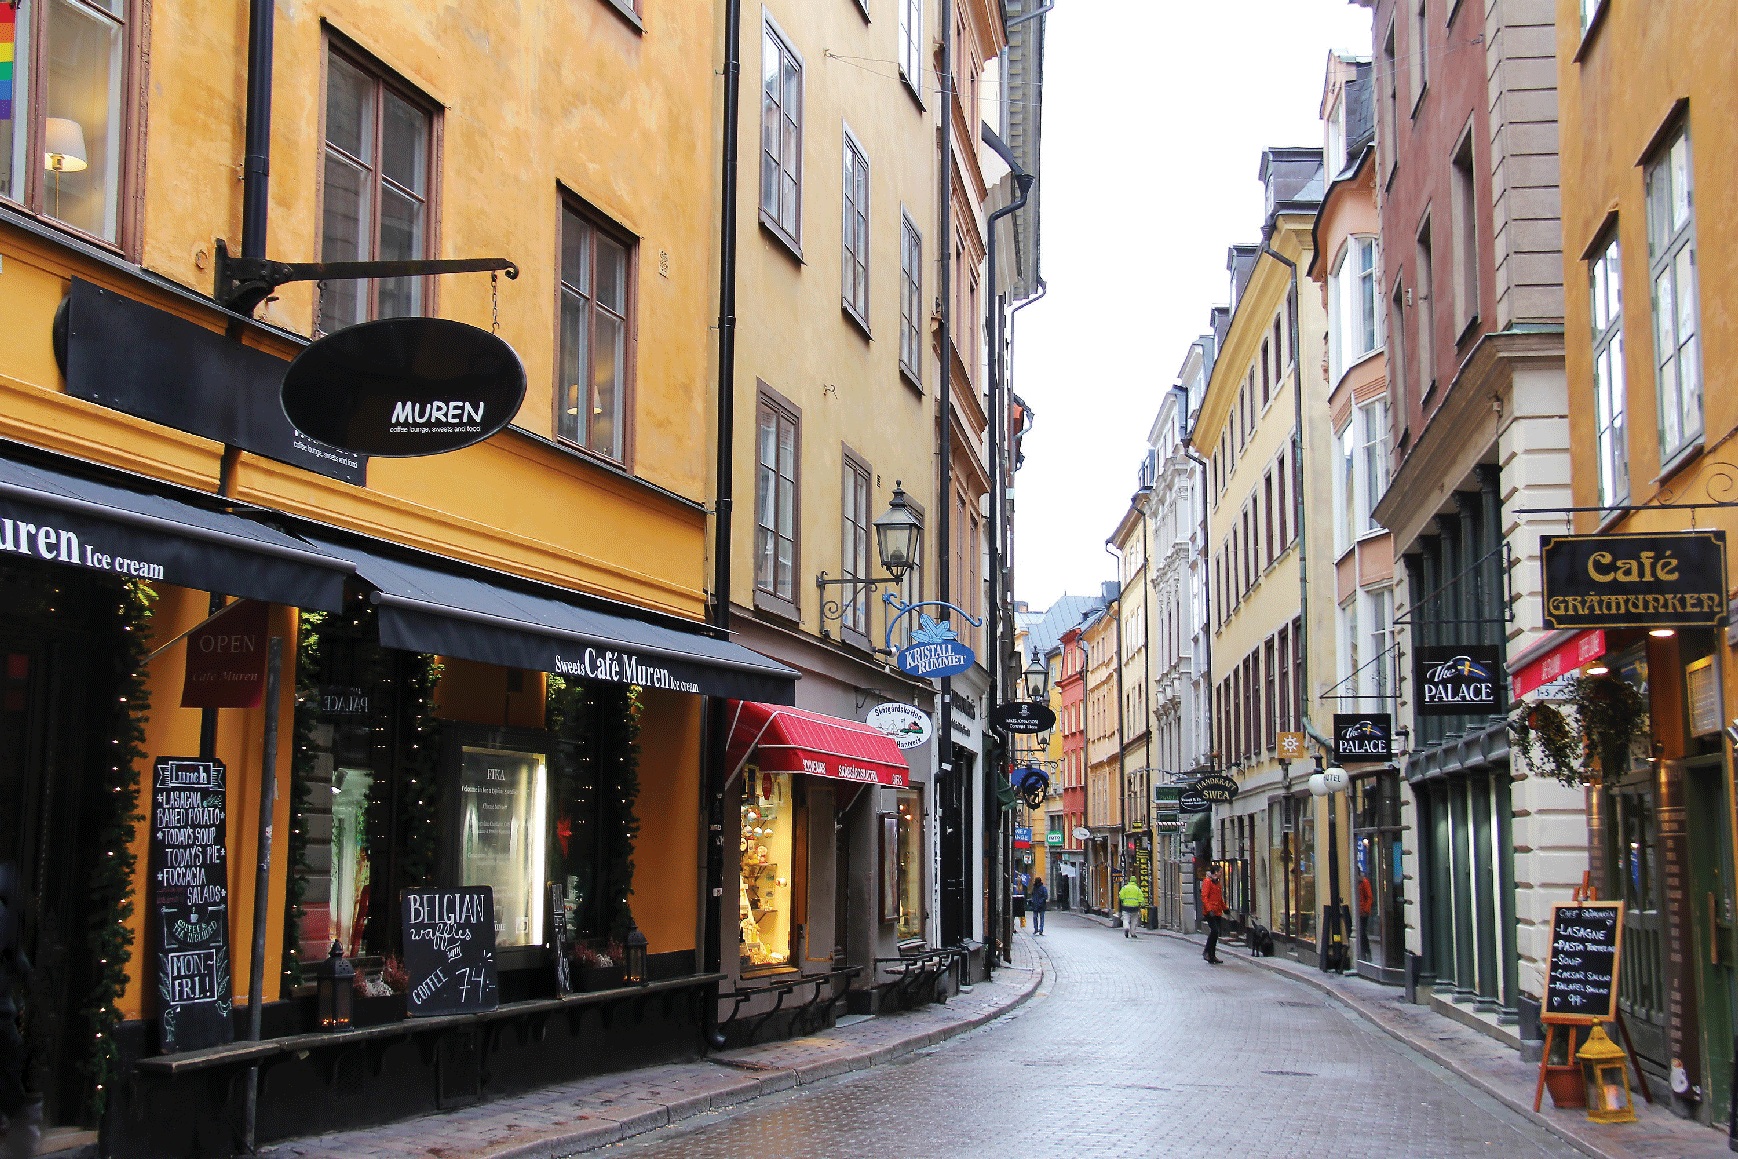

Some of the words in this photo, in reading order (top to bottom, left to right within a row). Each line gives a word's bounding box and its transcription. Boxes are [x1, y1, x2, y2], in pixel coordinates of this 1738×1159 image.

[391, 400, 485, 424] MUREN
[389, 425, 409, 434] coffee
[431, 426, 453, 434] sweets
[466, 425, 481, 433] food
[0, 517, 82, 565] uren
[85, 544, 112, 569] Ice
[115, 556, 164, 580] cream
[1587, 550, 1680, 583] Café
[1549, 592, 1722, 616] GRÅMUNKEN
[200, 634, 256, 653] OPEN
[904, 643, 955, 670] KRISTALL
[917, 654, 967, 675] RUMMET
[555, 654, 585, 676] Sweets
[584, 647, 620, 682] Café
[622, 653, 670, 690] Muren
[670, 675, 680, 691] Ice
[680, 680, 700, 693] cream
[1426, 660, 1460, 682] The
[1424, 682, 1494, 702] PALACE
[1339, 740, 1387, 753] PALACE
[171, 765, 208, 784] Lunch
[487, 768, 506, 781] FIKA
[163, 791, 202, 808] LASAGNA
[1202, 789, 1230, 800] SWEA
[157, 808, 186, 827] BAKED
[188, 807, 220, 825] POTATO
[163, 826, 194, 845] TODAY'S
[195, 826, 216, 845] SOUP
[165, 845, 202, 867] TODAY'S
[207, 844, 221, 864] PIE
[187, 885, 221, 905] SALADS
[407, 893, 485, 924] BELGIAN
[409, 922, 472, 951] waffles
[412, 966, 449, 1005] COFFEE
